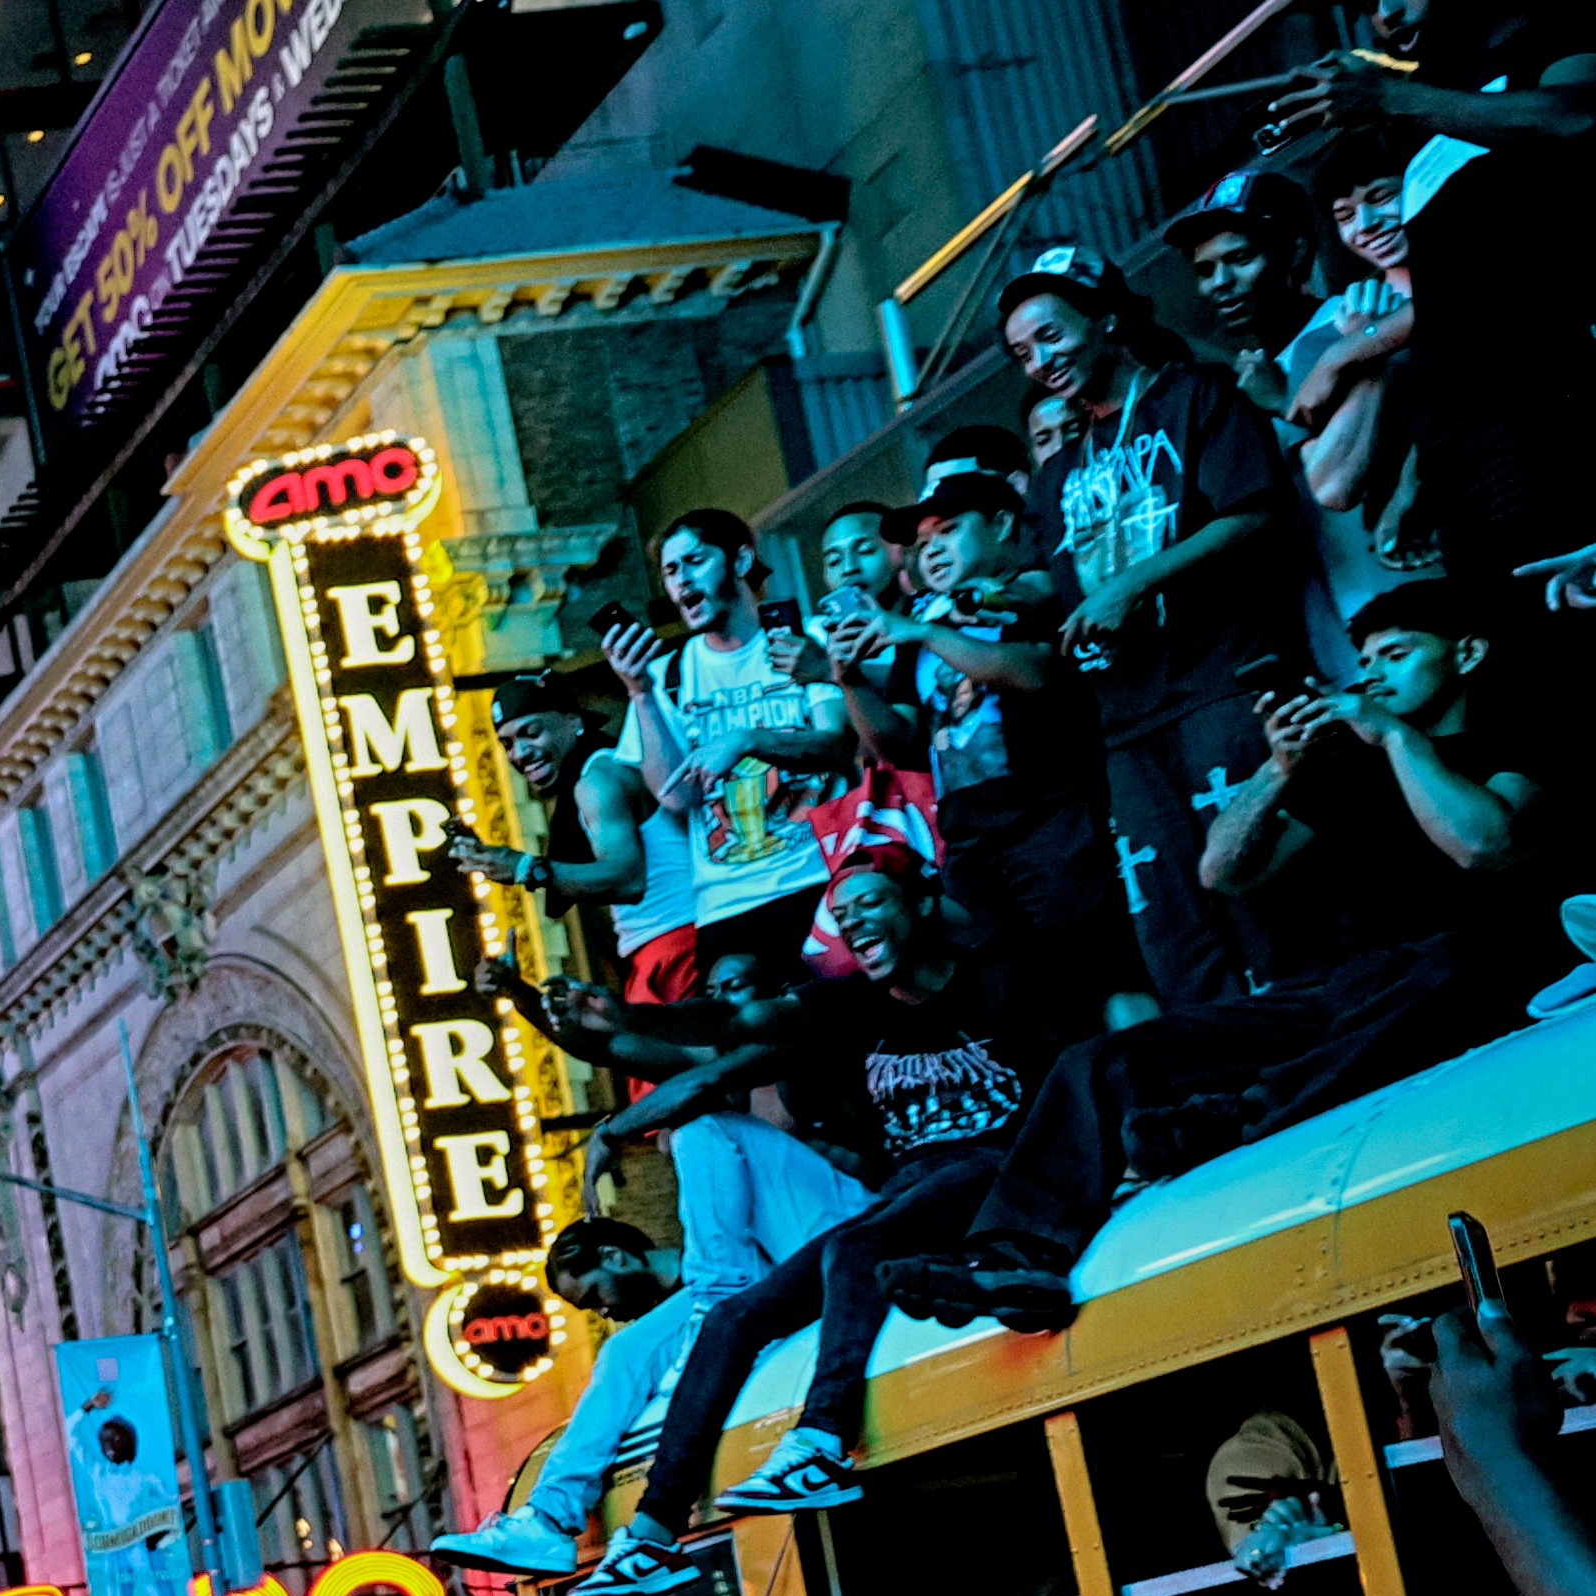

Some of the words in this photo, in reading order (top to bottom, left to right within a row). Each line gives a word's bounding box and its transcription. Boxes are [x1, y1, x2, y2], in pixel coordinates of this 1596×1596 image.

[47, 290, 97, 410] GET
[97, 190, 158, 322] 50%
[157, 79, 214, 213] OFF
[164, 86, 274, 284] TUESDAYS
[326, 579, 525, 1225] EMPIRE
[462, 1311, 549, 1343] amc
